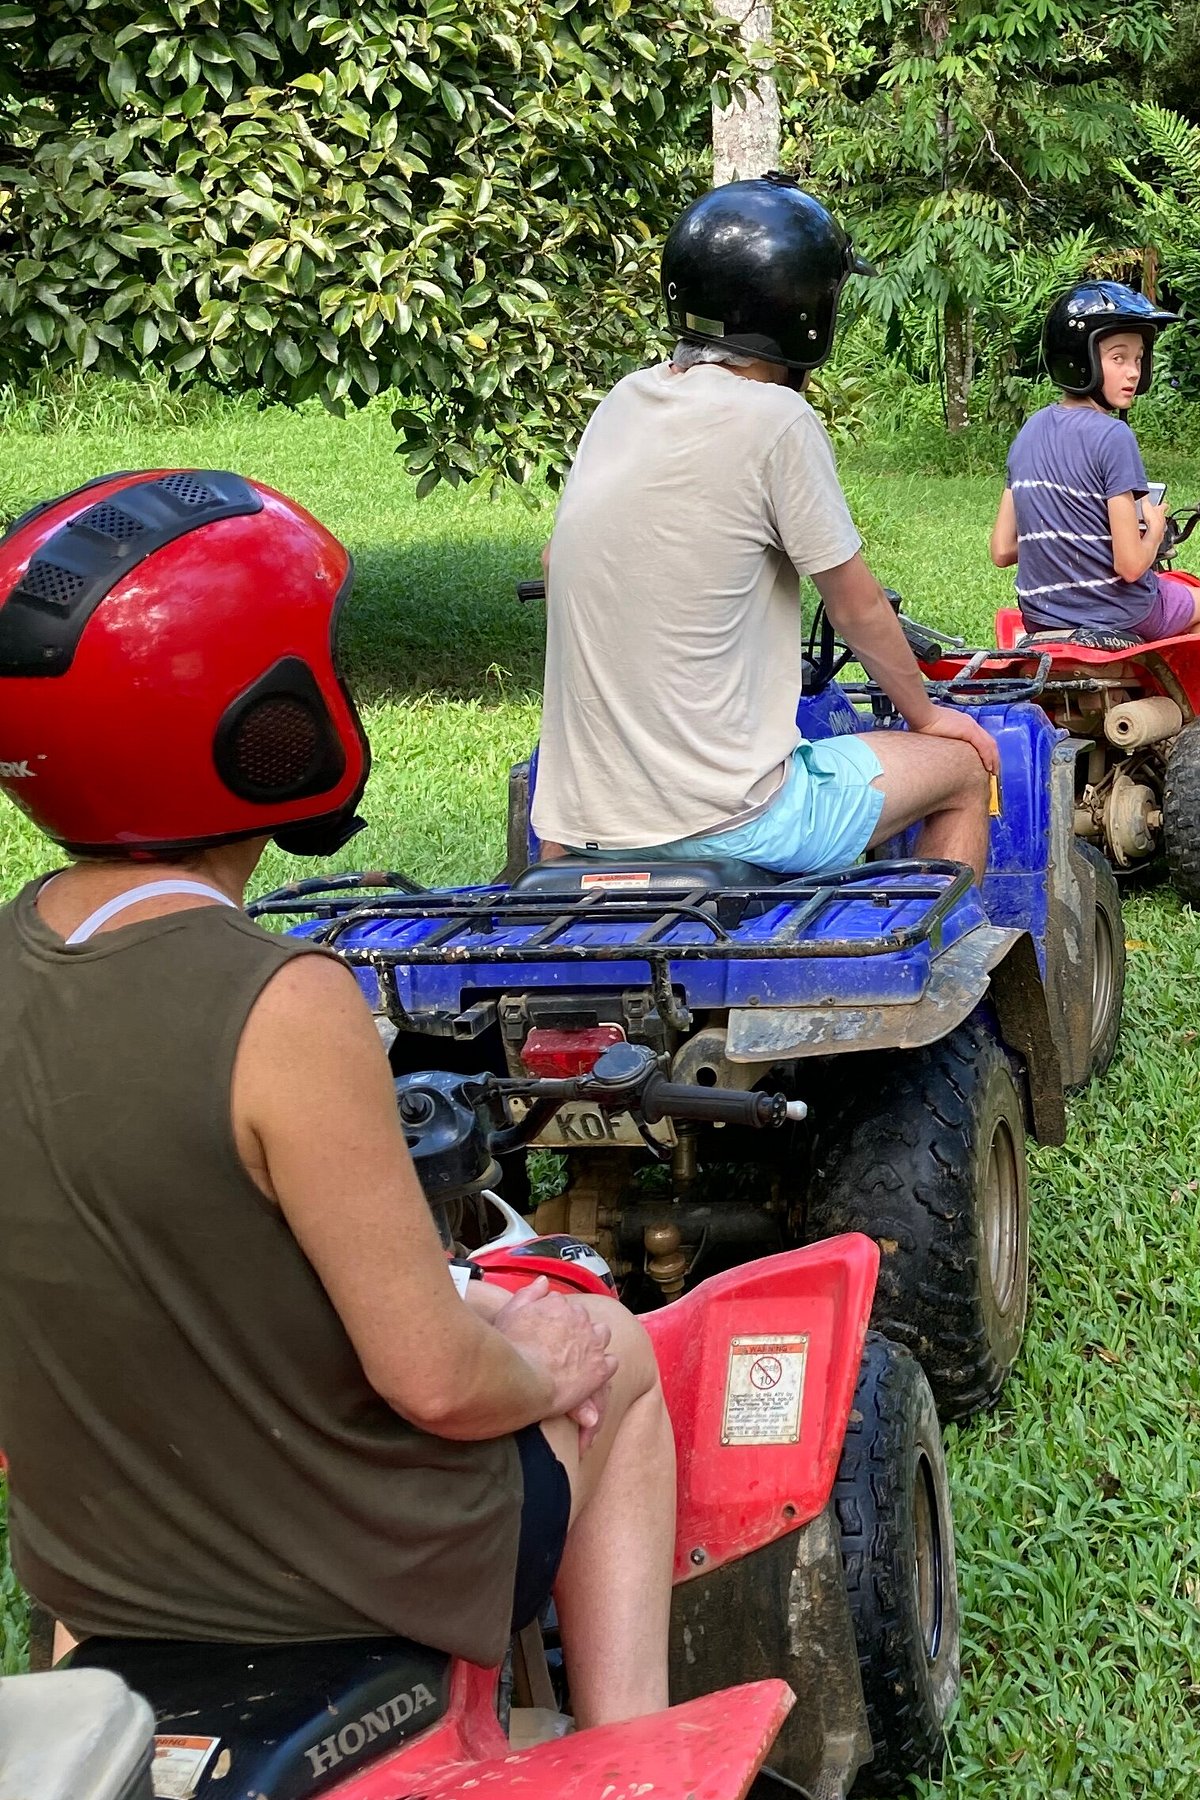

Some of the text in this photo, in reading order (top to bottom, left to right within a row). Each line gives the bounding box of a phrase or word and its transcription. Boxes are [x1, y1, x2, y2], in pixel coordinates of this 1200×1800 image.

[1102, 636, 1141, 649] HOND
[750, 1344, 788, 1353] WARNING
[304, 1683, 436, 1778] HONDA
